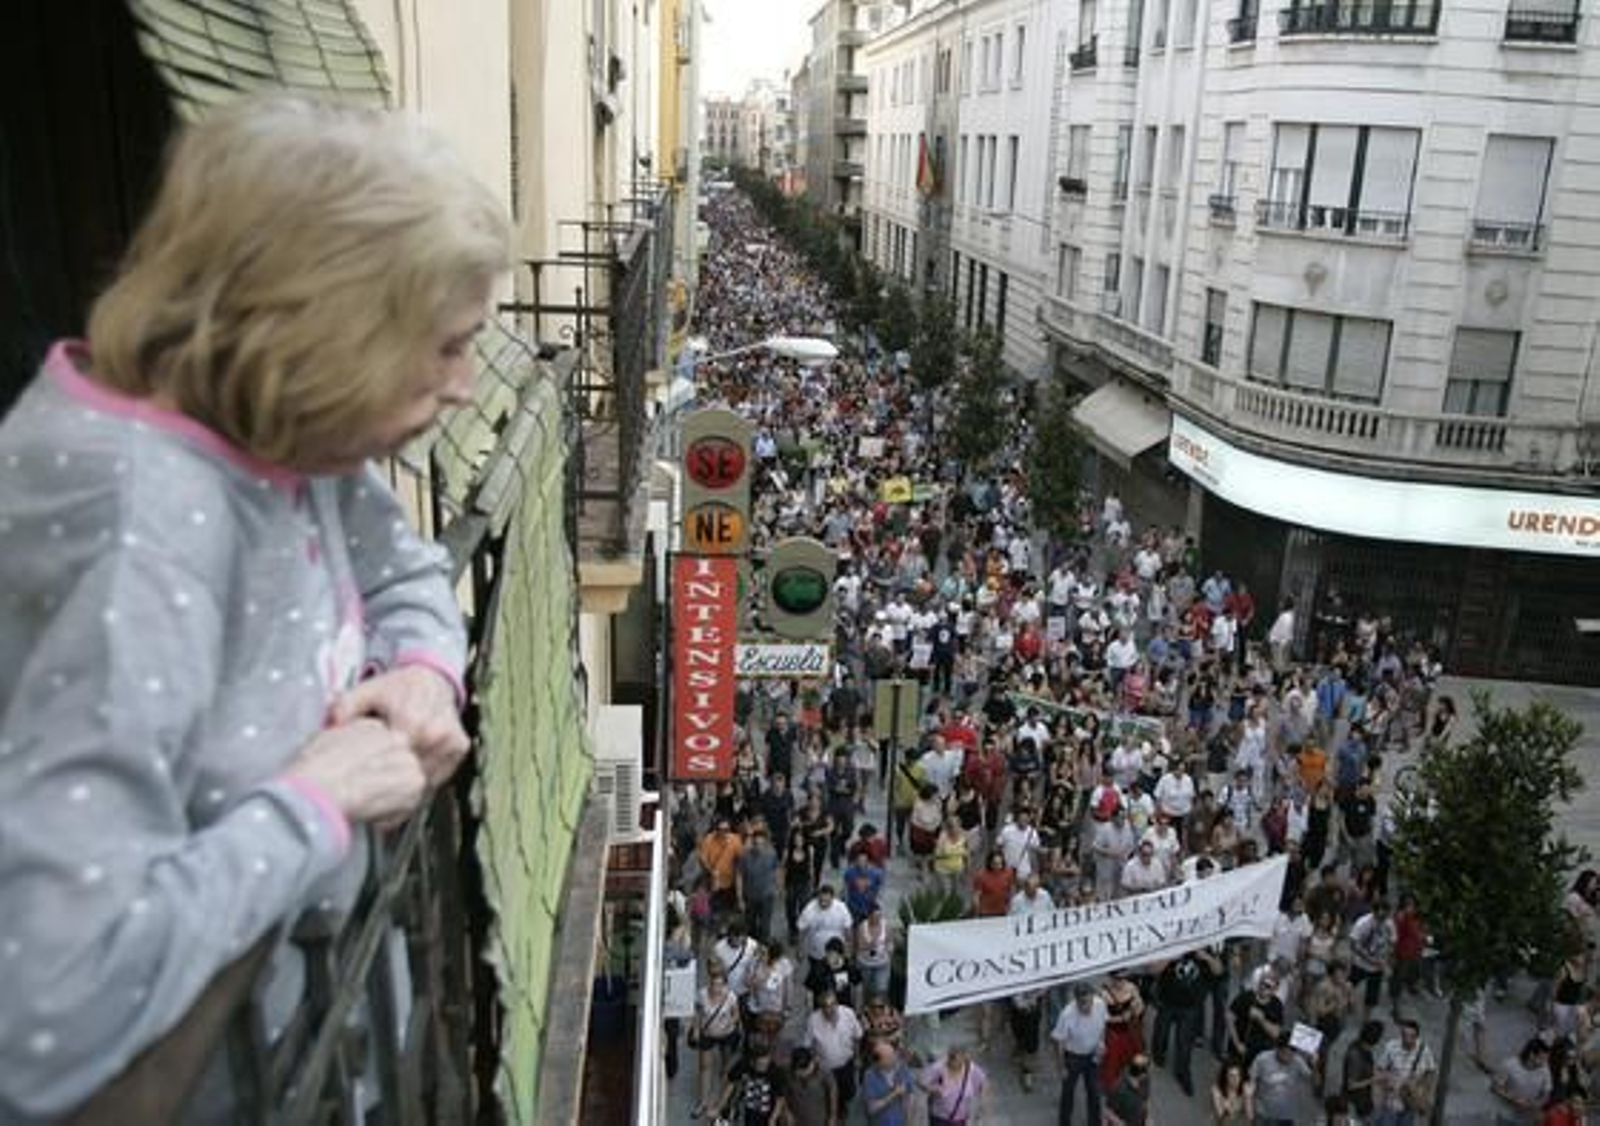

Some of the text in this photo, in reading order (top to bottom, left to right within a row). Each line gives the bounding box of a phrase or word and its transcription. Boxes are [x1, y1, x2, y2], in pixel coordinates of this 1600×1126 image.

[697, 447, 731, 480] SE
[696, 511, 732, 542] NE
[1508, 509, 1600, 537] UREND
[684, 559, 721, 772] INTENSIVOS
[739, 645, 822, 672] Escuela
